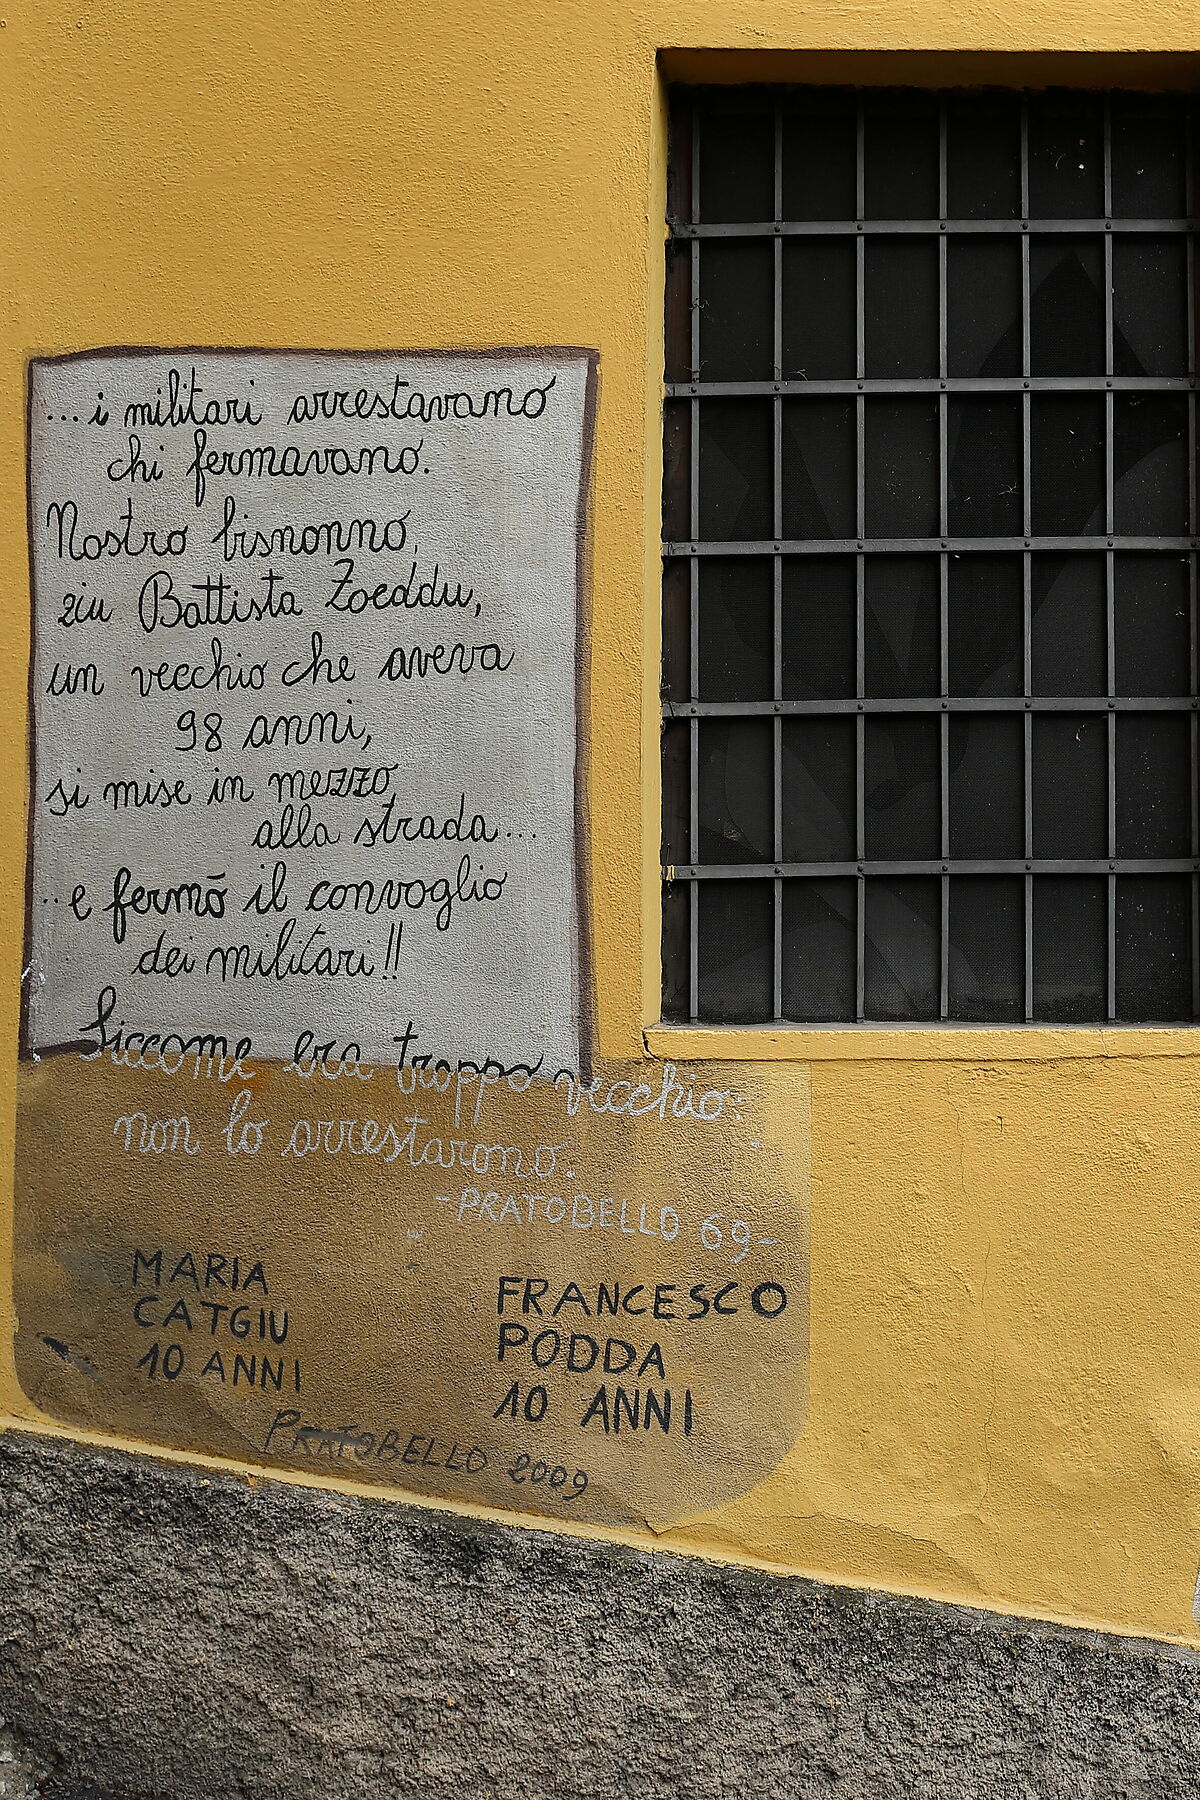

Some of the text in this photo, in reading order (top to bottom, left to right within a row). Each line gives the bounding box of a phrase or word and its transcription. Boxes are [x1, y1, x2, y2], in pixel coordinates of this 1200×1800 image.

[124, 366, 263, 427] militari
[286, 374, 556, 426] arrestavano
[106, 428, 431, 508] chi fermavano.
[46, 497, 188, 562] Nostro
[138, 568, 304, 634] Battista
[325, 558, 482, 618] Zoeddu,
[45, 631, 515, 698] un vecchio che aveva
[175, 698, 373, 752] 98 anni,
[44, 762, 399, 816] si mise in mezzo
[250, 803, 340, 849] alla
[242, 861, 288, 915] il
[304, 854, 508, 931] convoglio
[131, 930, 196, 978] dei
[79, 985, 257, 1083] Siccome
[392, 1021, 545, 1129] troppo
[113, 1088, 576, 1180] non lo arrestarono.
[132, 1248, 270, 1295] MARIA
[497, 1275, 788, 1320] FRANCESCO
[133, 1297, 290, 1346] CATGIU
[137, 1341, 302, 1392] 10 ANNI
[497, 1322, 666, 1379] PODDA
[492, 1382, 694, 1437] 10 ANNI
[508, 1453, 589, 1501] 2009
